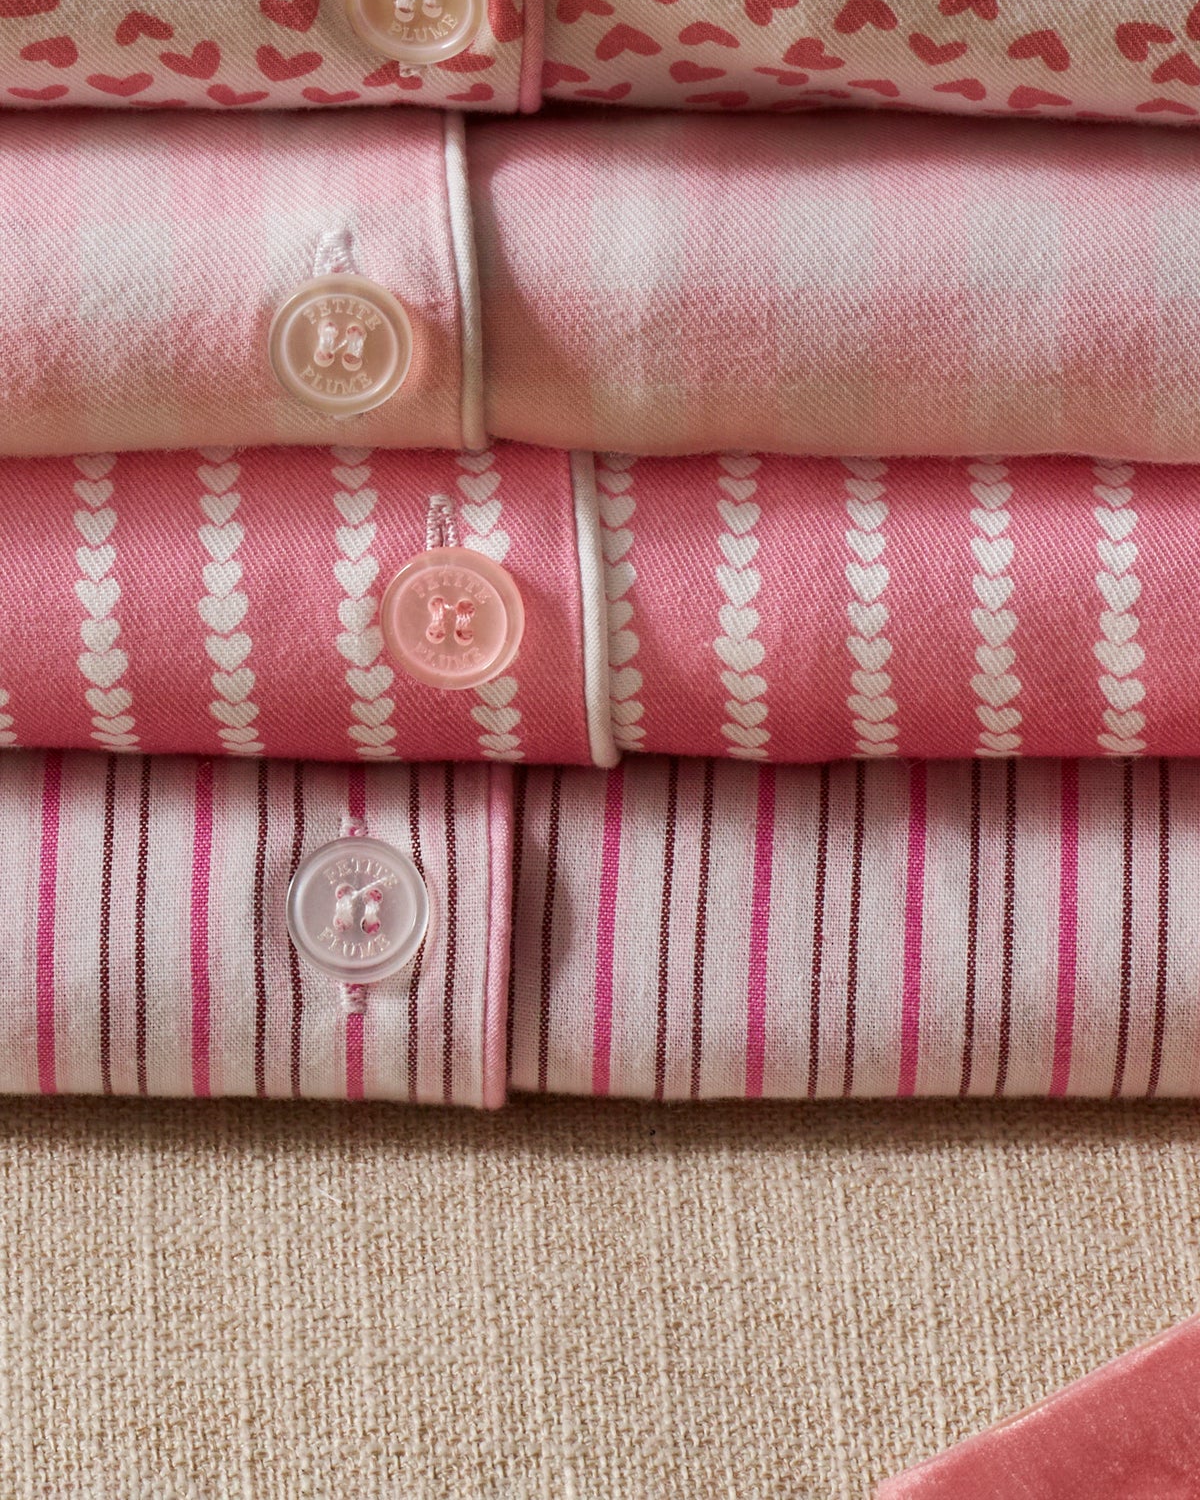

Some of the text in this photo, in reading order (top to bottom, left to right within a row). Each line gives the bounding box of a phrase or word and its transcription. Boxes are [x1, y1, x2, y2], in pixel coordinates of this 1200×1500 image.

[388, 12, 459, 42] PLUME
[303, 299, 382, 332] PETITE
[300, 364, 373, 395] PLUME
